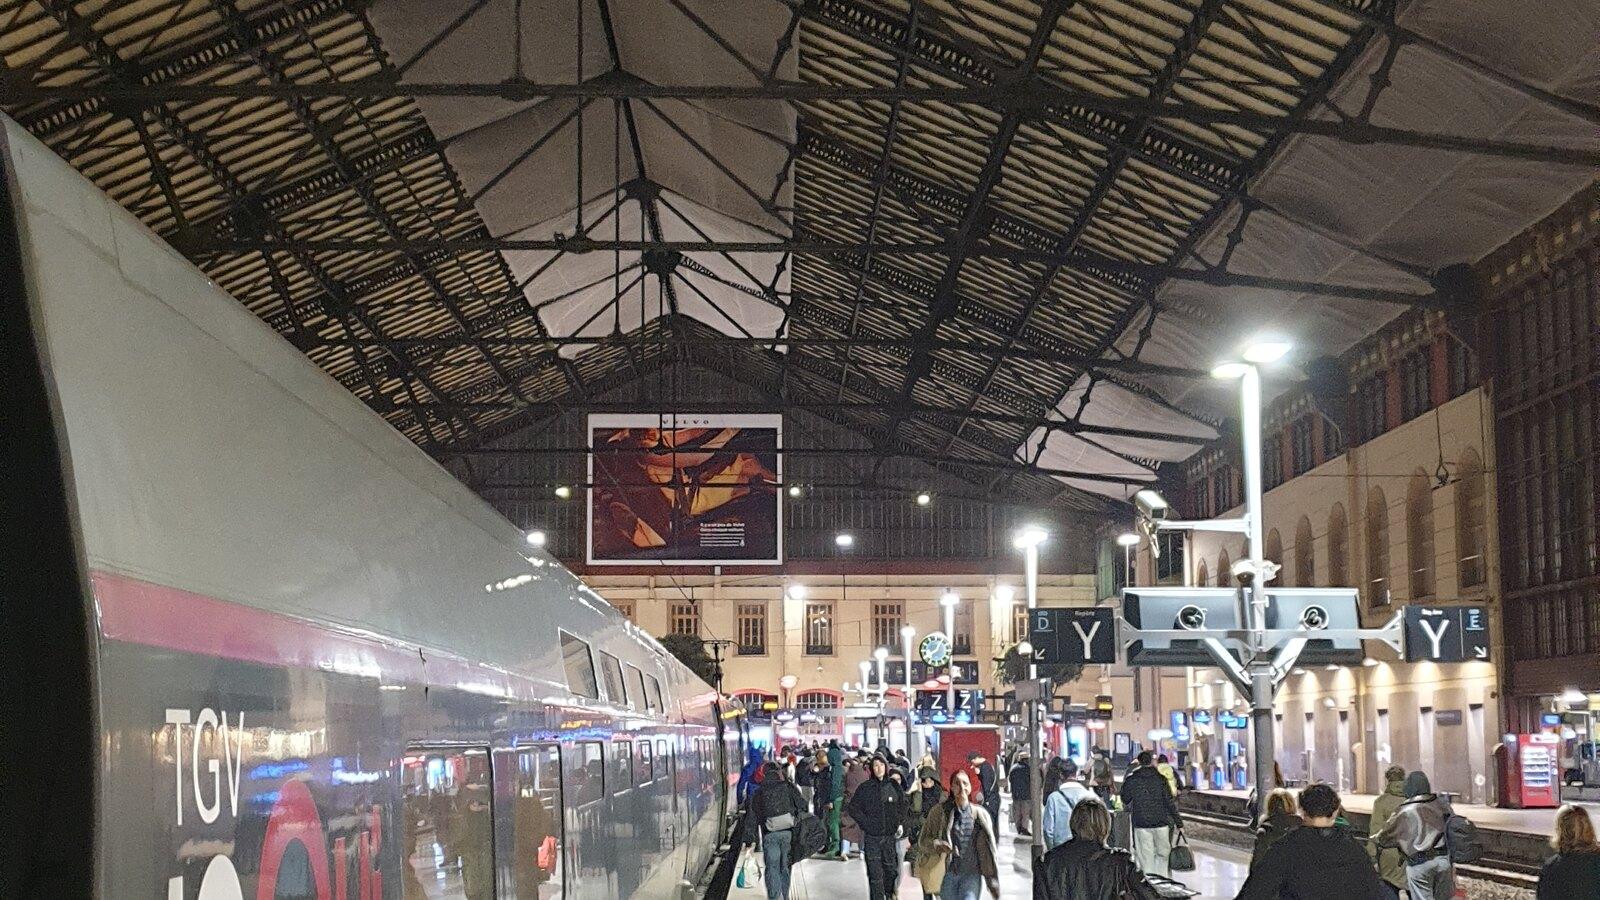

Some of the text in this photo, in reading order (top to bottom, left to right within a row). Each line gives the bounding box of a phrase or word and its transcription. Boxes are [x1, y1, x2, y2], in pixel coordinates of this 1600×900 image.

[1037, 617, 1049, 630] D
[1469, 615, 1480, 628] E
[1072, 620, 1101, 660] Y
[1419, 619, 1450, 658] Y
[931, 694, 943, 709] Z
[960, 693, 971, 709] Z
[165, 707, 245, 826] TGV
